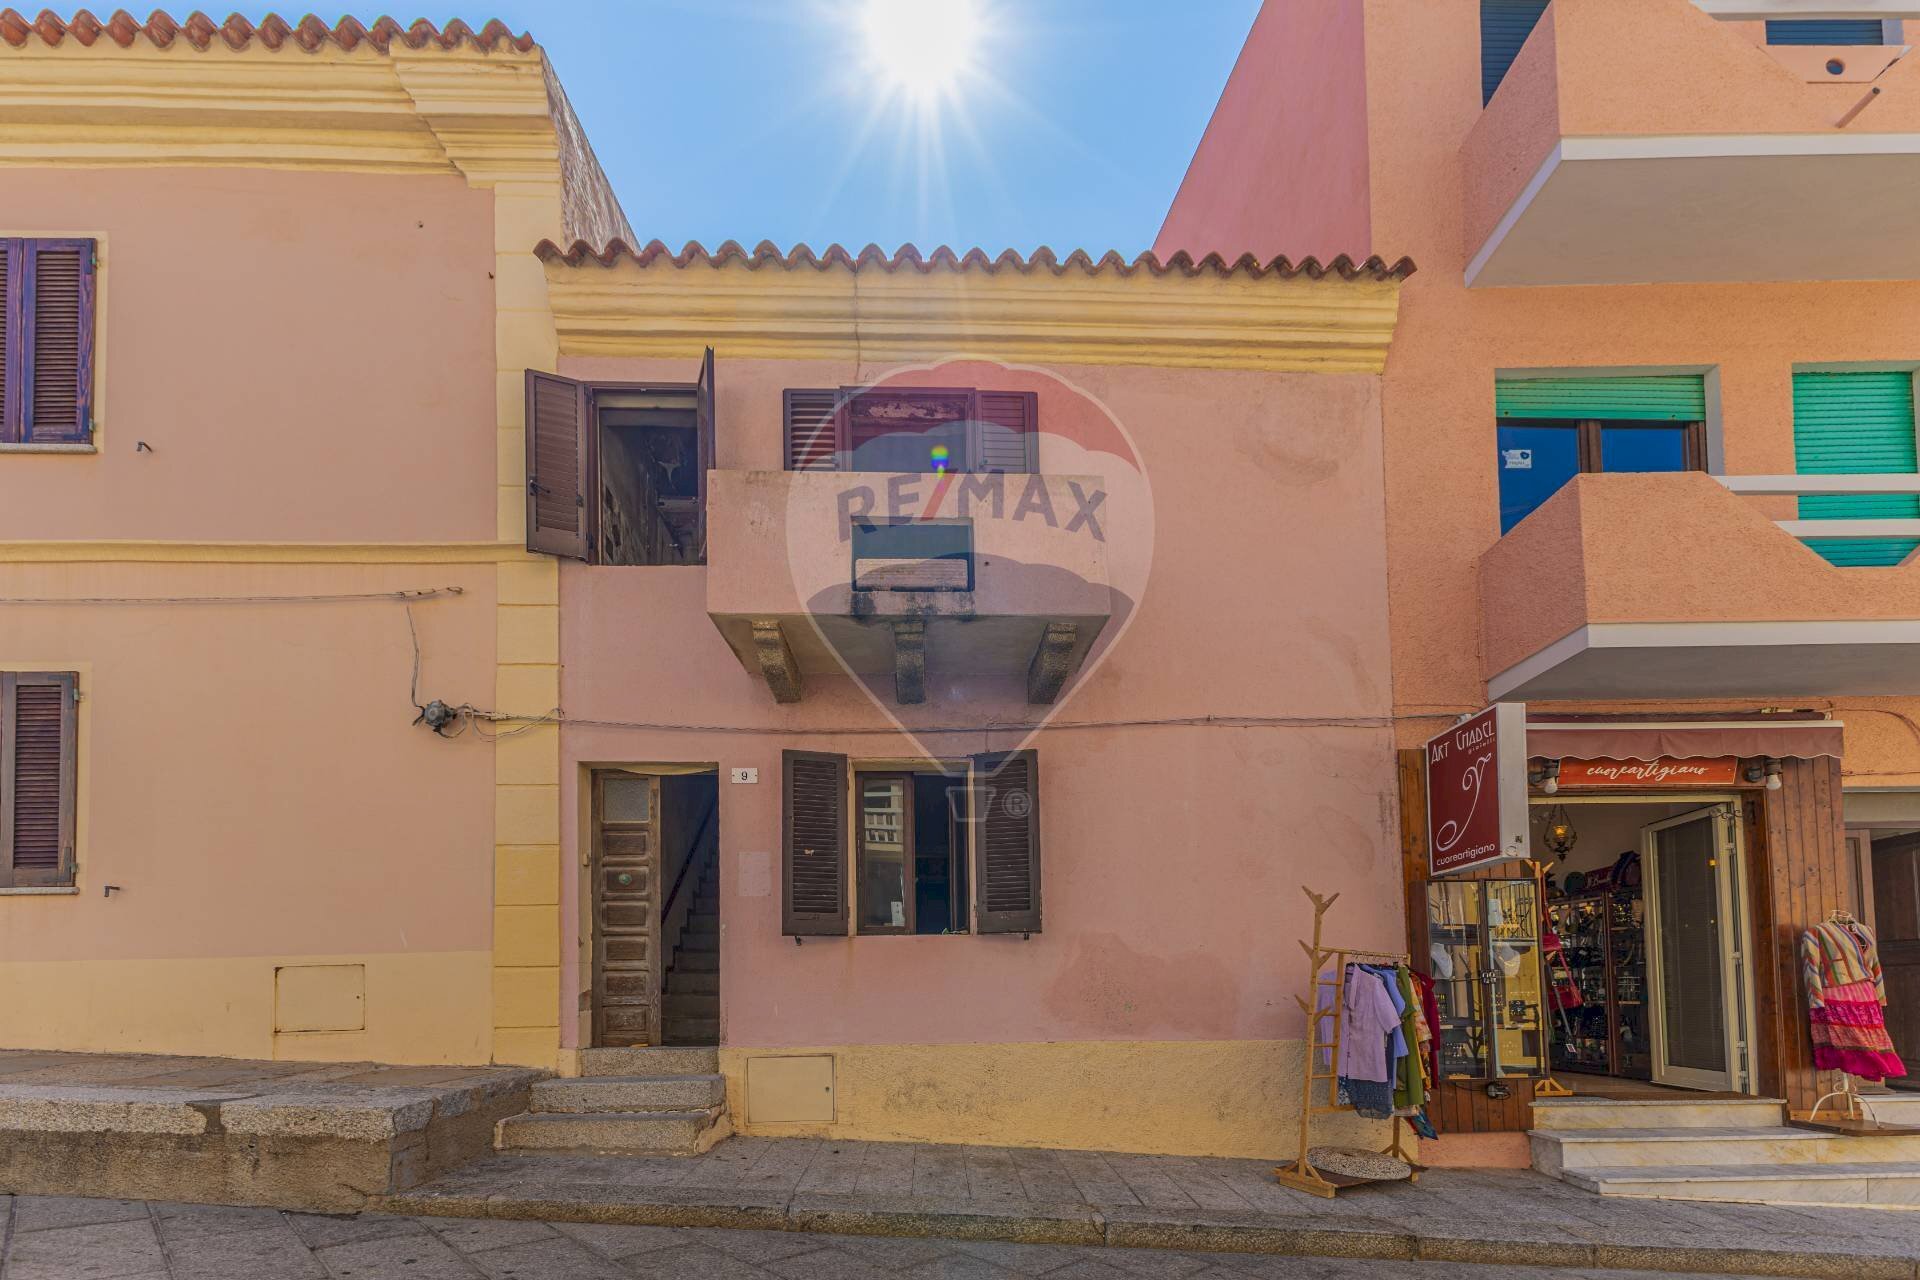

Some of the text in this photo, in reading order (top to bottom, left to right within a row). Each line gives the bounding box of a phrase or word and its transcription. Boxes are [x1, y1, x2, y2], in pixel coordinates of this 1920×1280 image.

[1431, 741, 1450, 765] ART
[740, 771, 748, 781] 9
[1586, 759, 1709, 781] cuoreartigiano
[1435, 842, 1496, 866] cuoreartigiano
